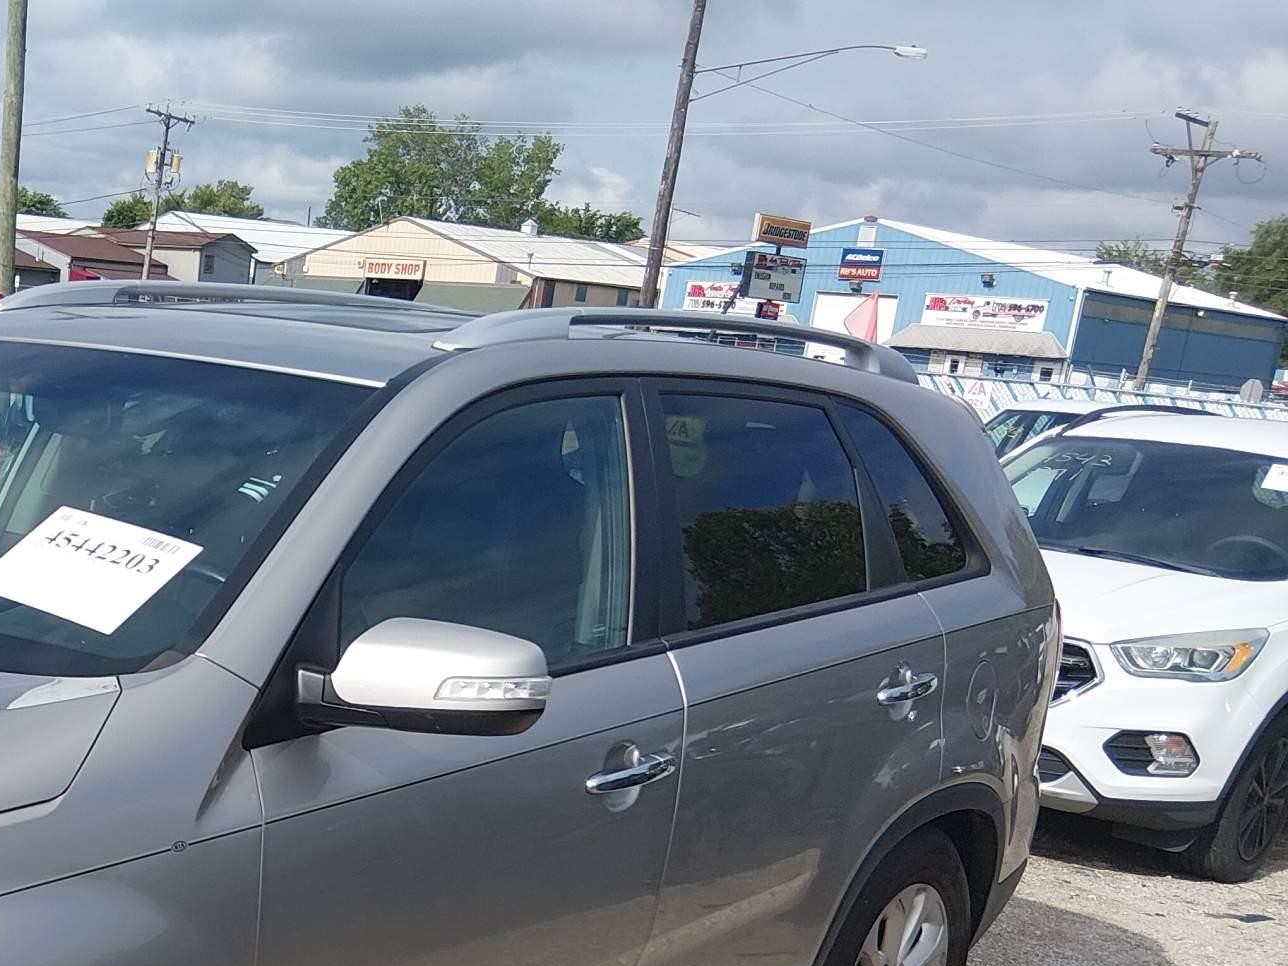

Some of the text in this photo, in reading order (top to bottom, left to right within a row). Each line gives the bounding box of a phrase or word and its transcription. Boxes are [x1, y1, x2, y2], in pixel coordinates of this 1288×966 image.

[367, 262, 421, 276] BODY SHOP
[857, 268, 878, 277] AUTO
[43, 529, 161, 574] 45442203
